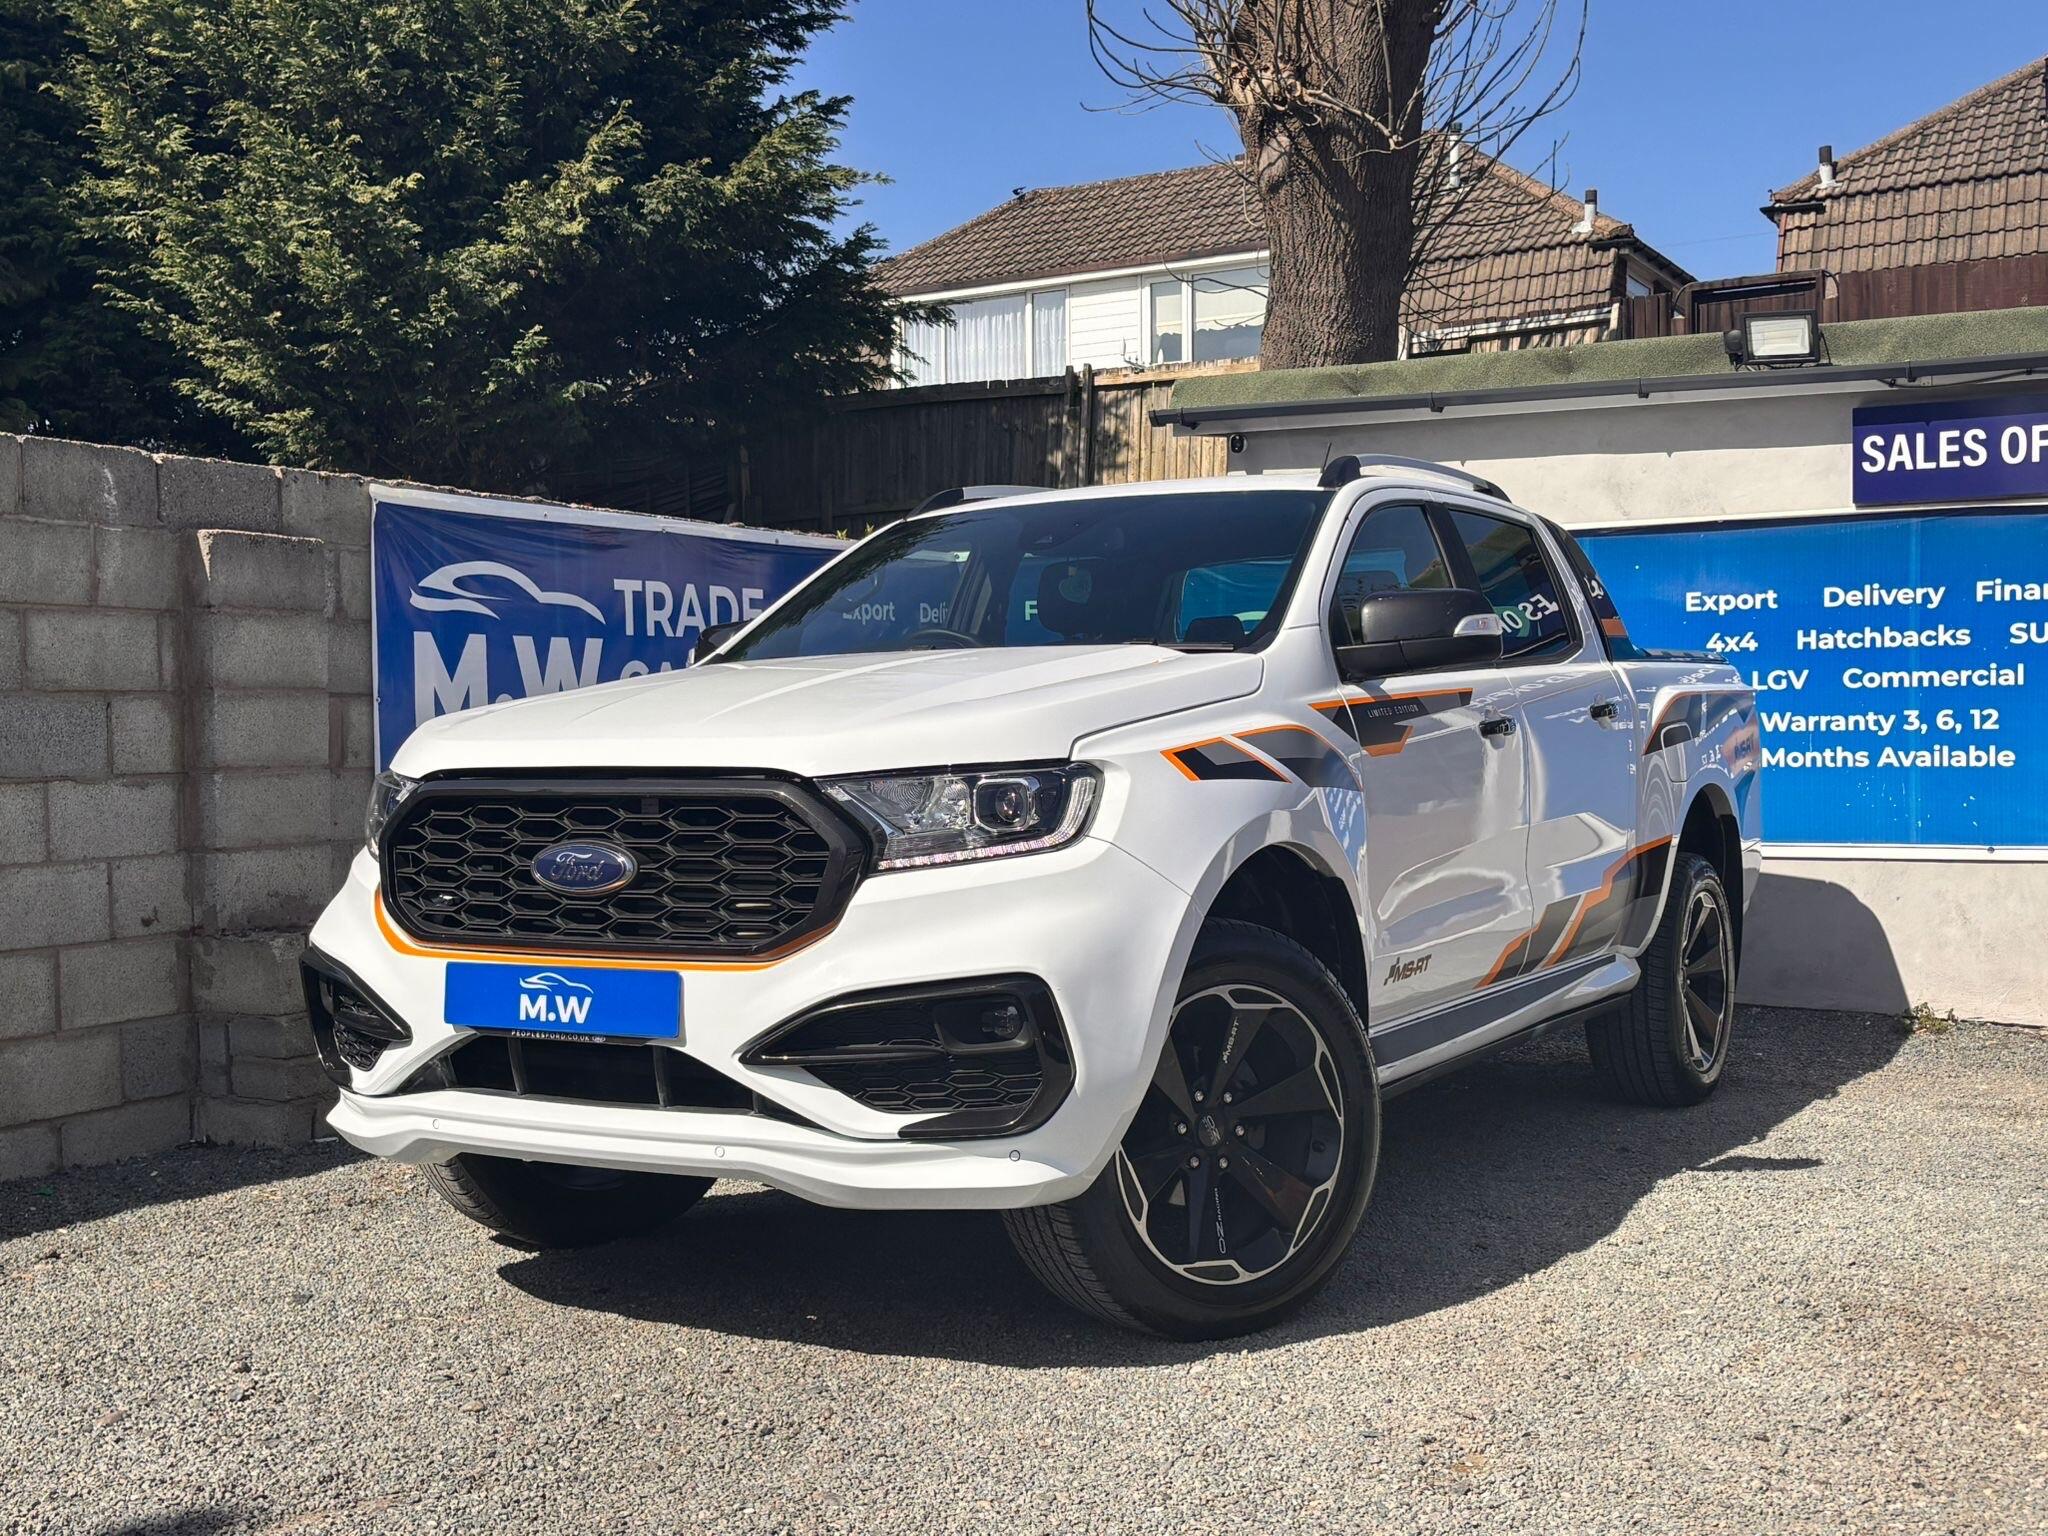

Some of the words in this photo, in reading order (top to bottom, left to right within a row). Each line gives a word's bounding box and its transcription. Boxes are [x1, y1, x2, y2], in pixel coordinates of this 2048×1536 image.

[1860, 428, 1988, 474] SALES
[2000, 423, 2048, 465] OF
[1685, 589, 1779, 616] Export
[1823, 583, 1946, 610] Delivery
[1976, 578, 2048, 602] Fina
[1706, 631, 1759, 652] 4x4
[1796, 624, 1972, 650] Hatchbacks
[1752, 669, 1809, 691] LGV
[1842, 663, 2025, 689] Commercial
[1367, 706, 1393, 718] LIMITED
[1394, 704, 1419, 714] EDITION
[1760, 711, 1896, 736] Warranty
[1902, 709, 1928, 735] 3,
[1935, 709, 1963, 735] 6,
[1970, 709, 2000, 730] 12
[1761, 746, 1870, 768] Months
[1876, 745, 2016, 768] Available
[550, 851, 606, 881] Ford
[519, 993, 593, 1025] M.W
[511, 1029, 590, 1042] PEOPLESFORD.CO.UK
